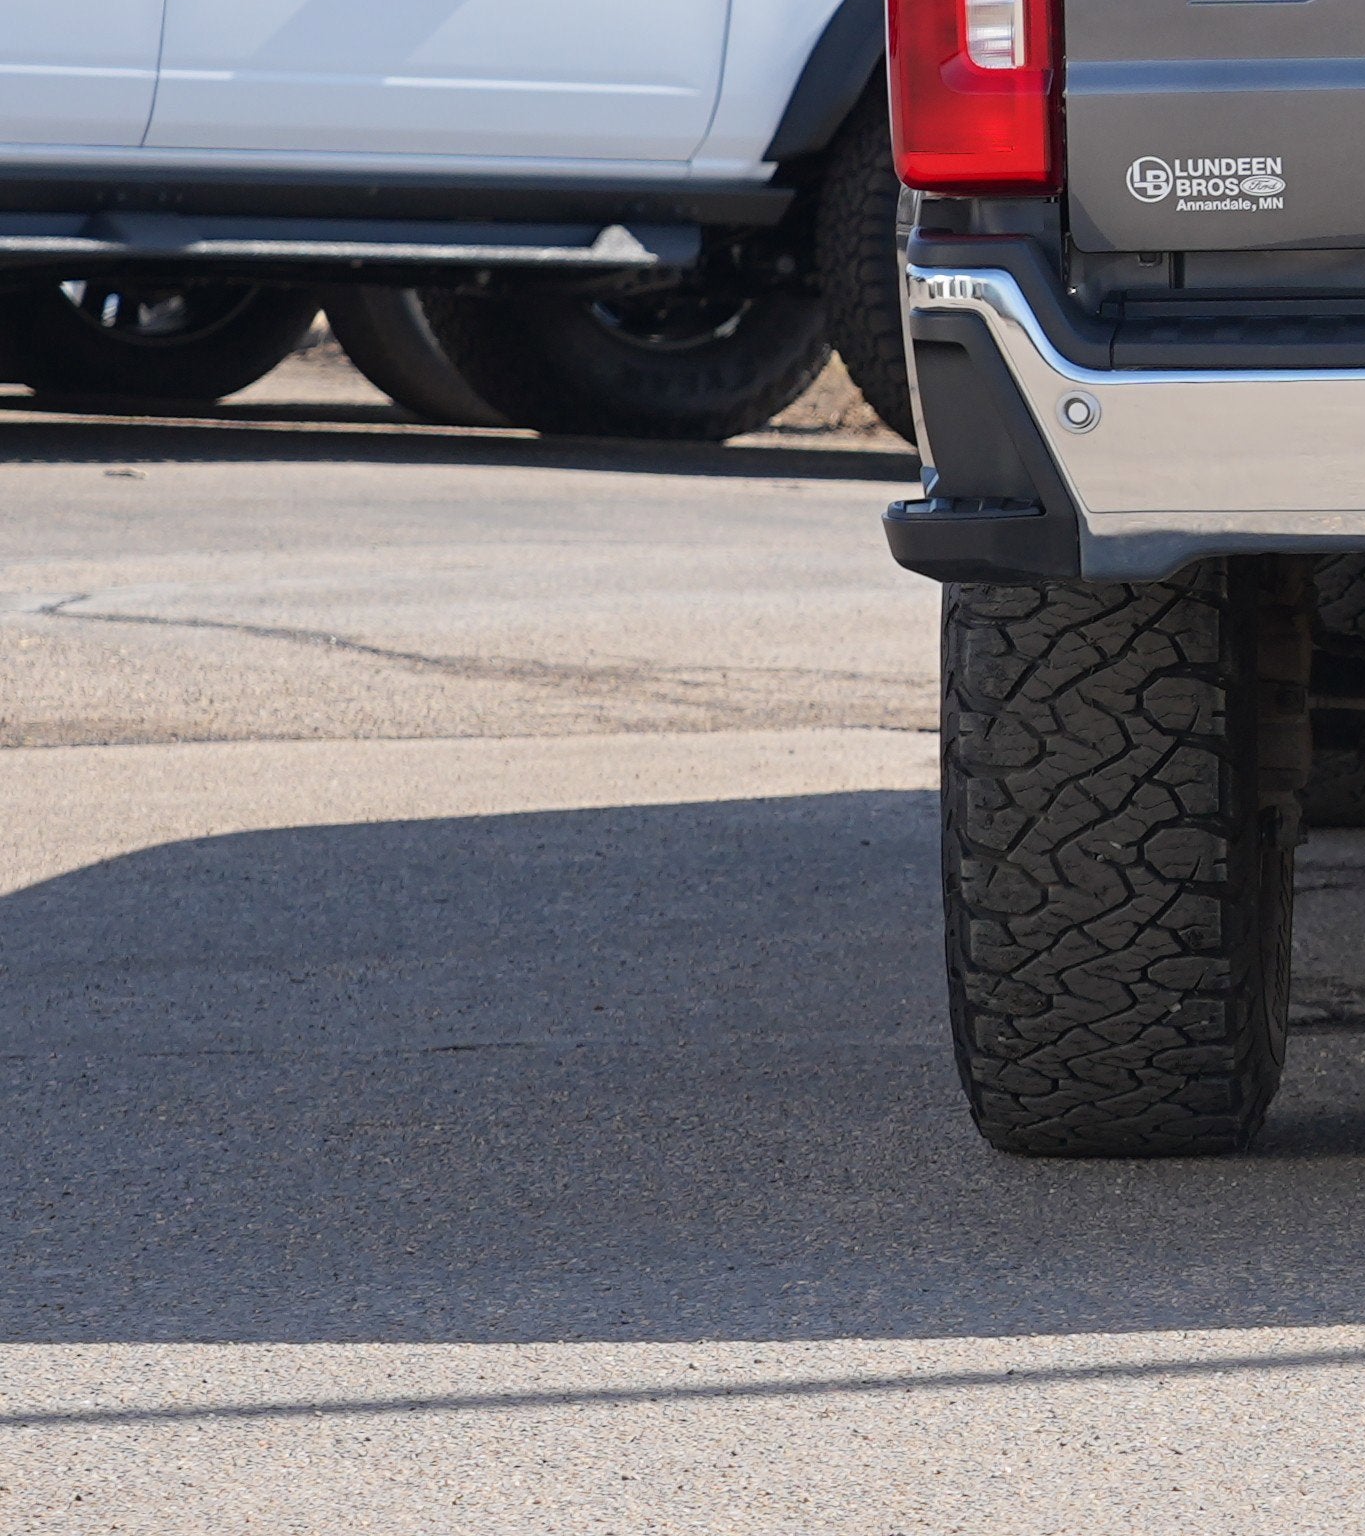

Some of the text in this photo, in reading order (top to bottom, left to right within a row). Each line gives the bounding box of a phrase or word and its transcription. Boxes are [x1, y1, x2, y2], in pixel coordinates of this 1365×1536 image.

[1174, 157, 1283, 177] LUNDEEN
[1176, 177, 1240, 197] BROS
[1176, 197, 1284, 212] Annandale, MN
